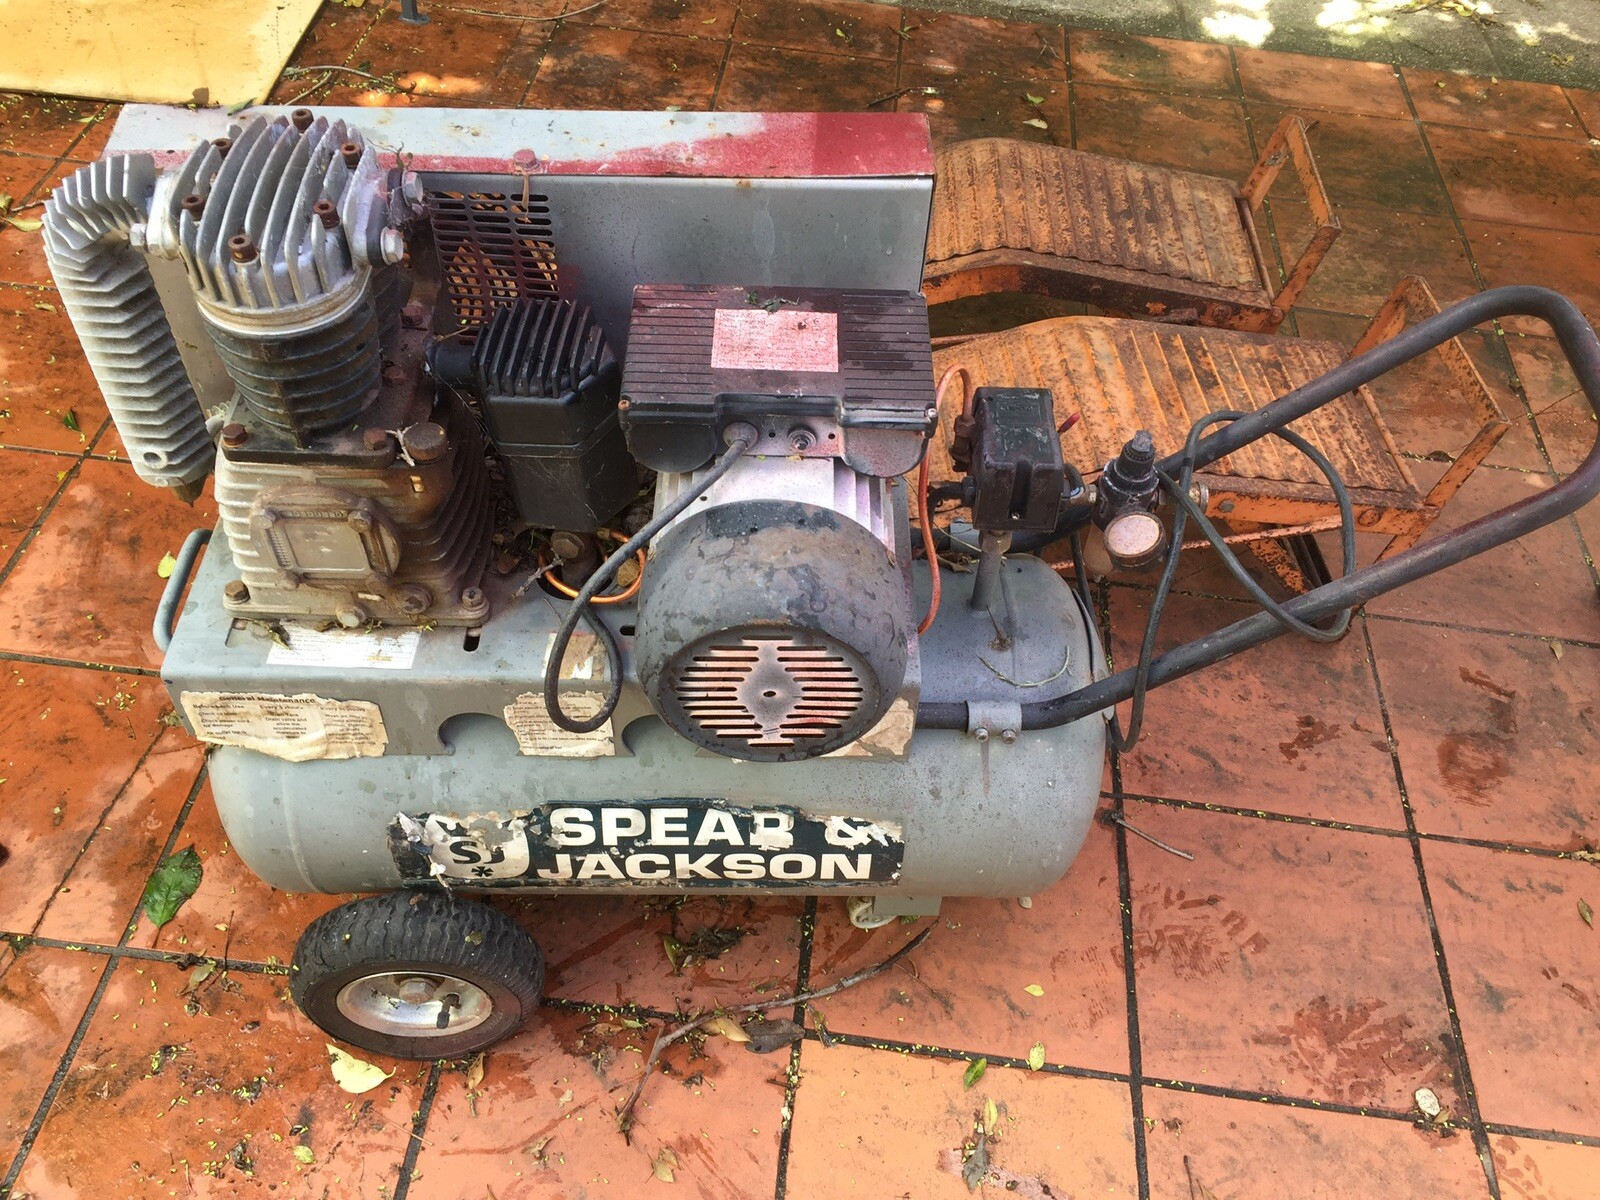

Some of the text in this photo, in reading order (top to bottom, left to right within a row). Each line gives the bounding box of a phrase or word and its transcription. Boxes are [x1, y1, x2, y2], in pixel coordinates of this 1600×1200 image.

[257, 696, 316, 704] Maintenance
[550, 807, 872, 850] SPEAR &
[537, 853, 873, 880] JACKSON
